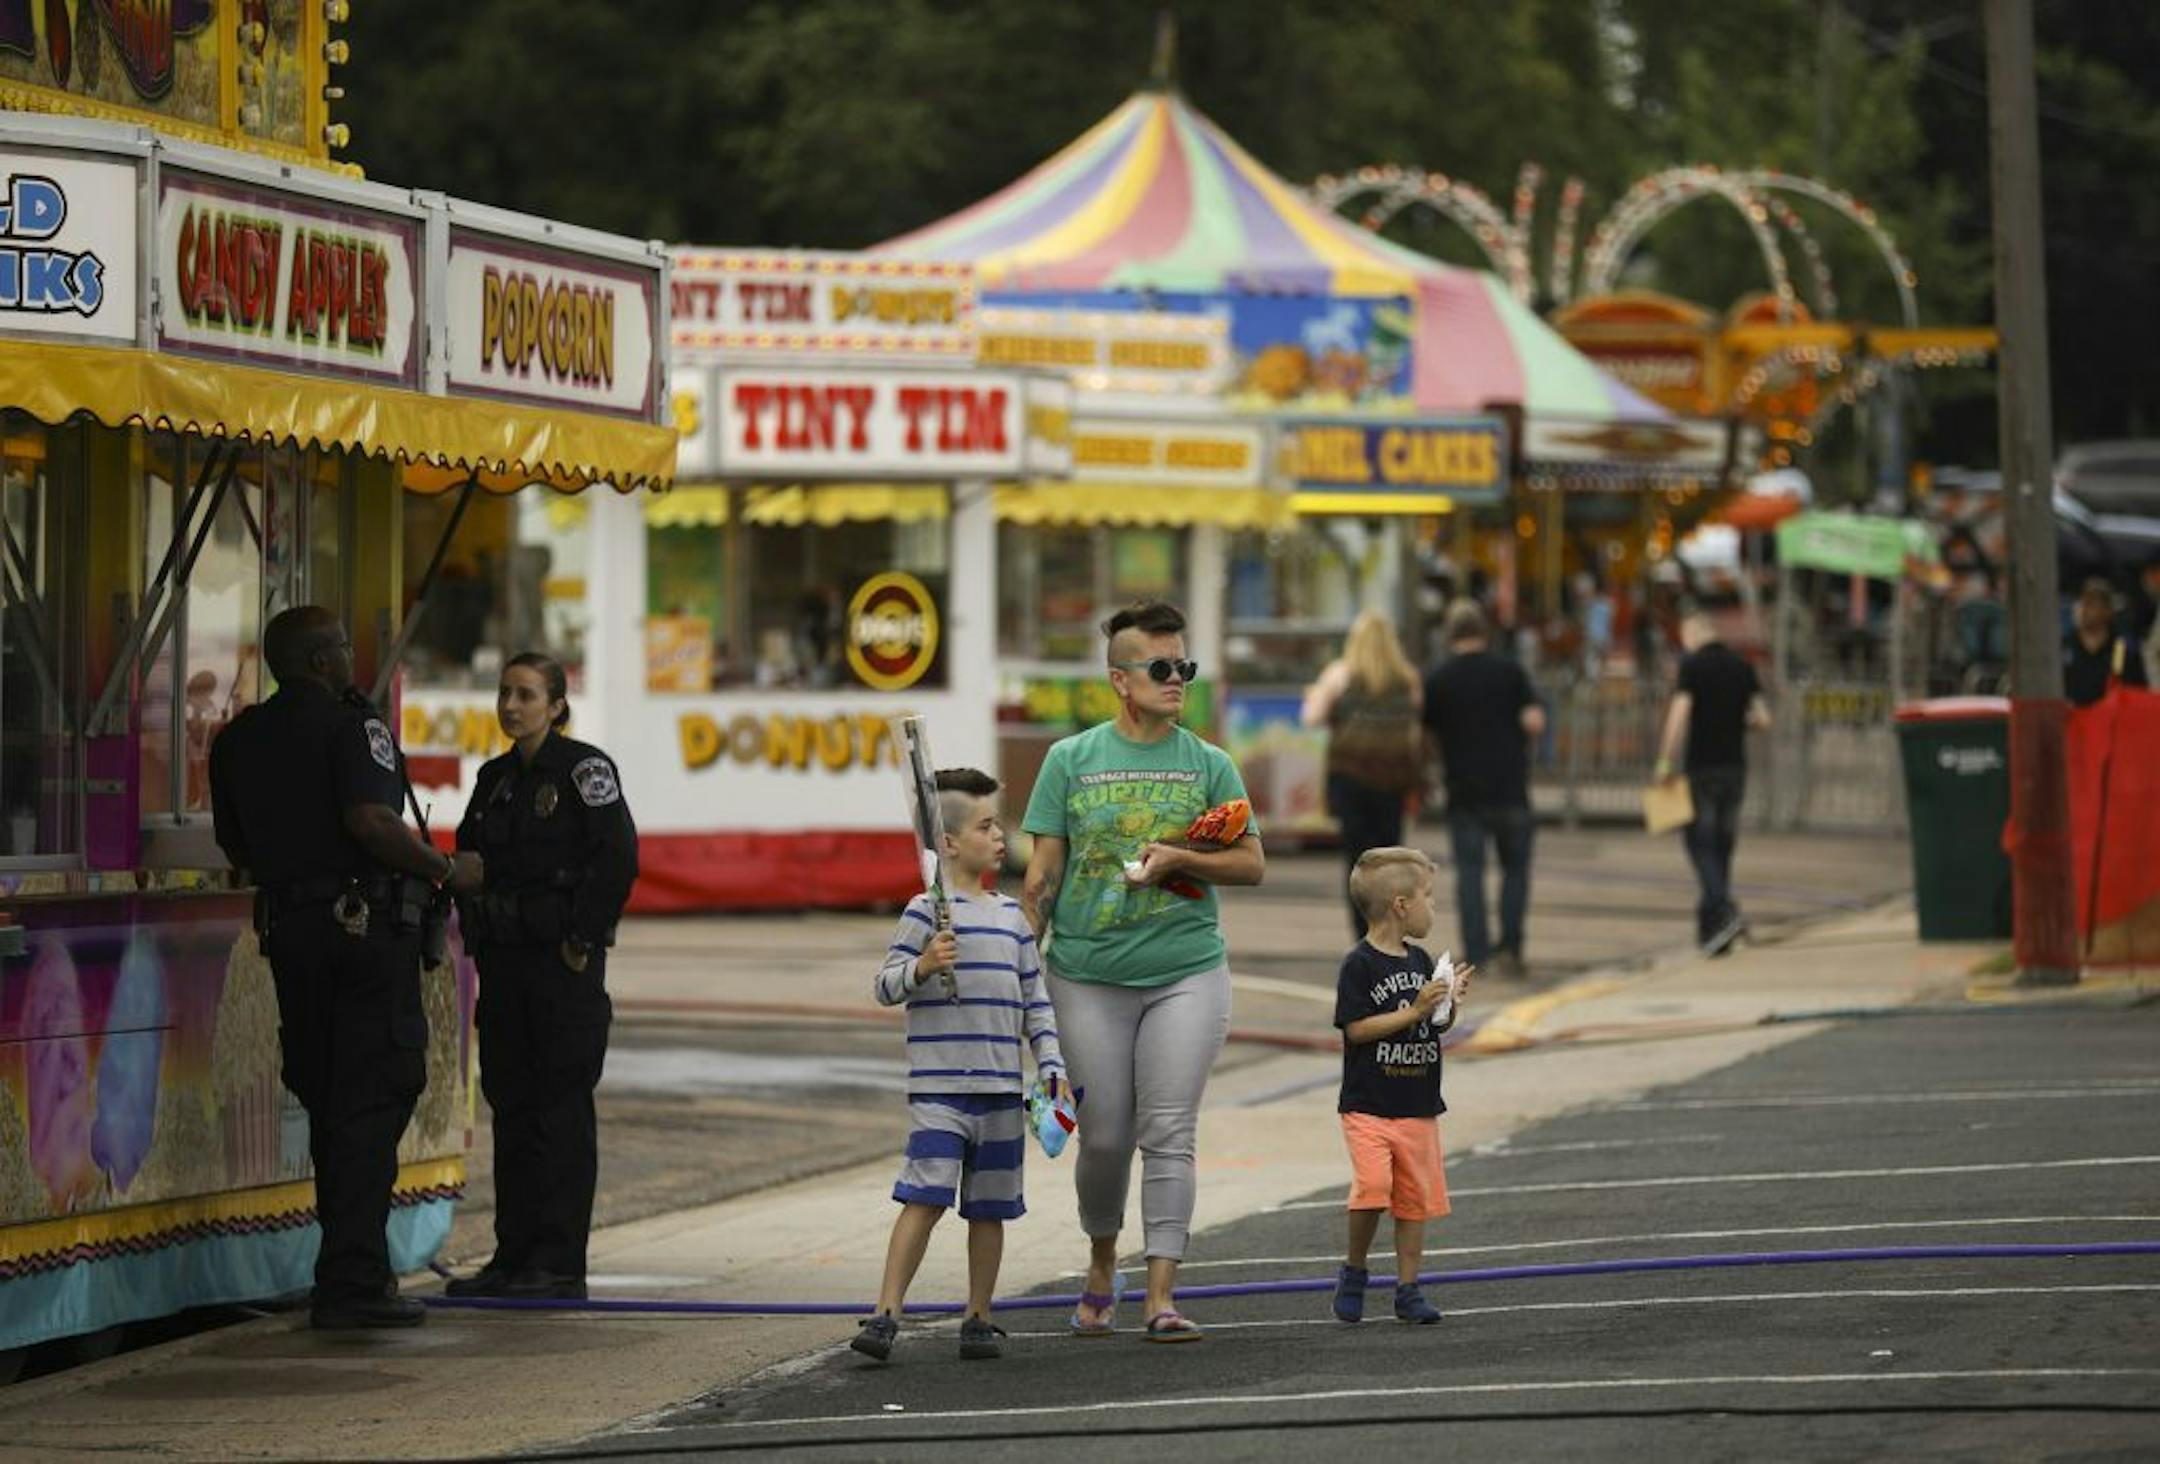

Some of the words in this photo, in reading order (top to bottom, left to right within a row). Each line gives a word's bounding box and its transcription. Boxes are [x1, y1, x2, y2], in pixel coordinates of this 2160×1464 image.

[178, 202, 284, 337] CANDY
[286, 225, 390, 357] APPLES
[738, 283, 812, 322] TIM
[481, 264, 615, 391] POPCORN
[735, 384, 874, 450] TINY
[898, 387, 1008, 452] TIM
[1379, 427, 1497, 486] CAKES
